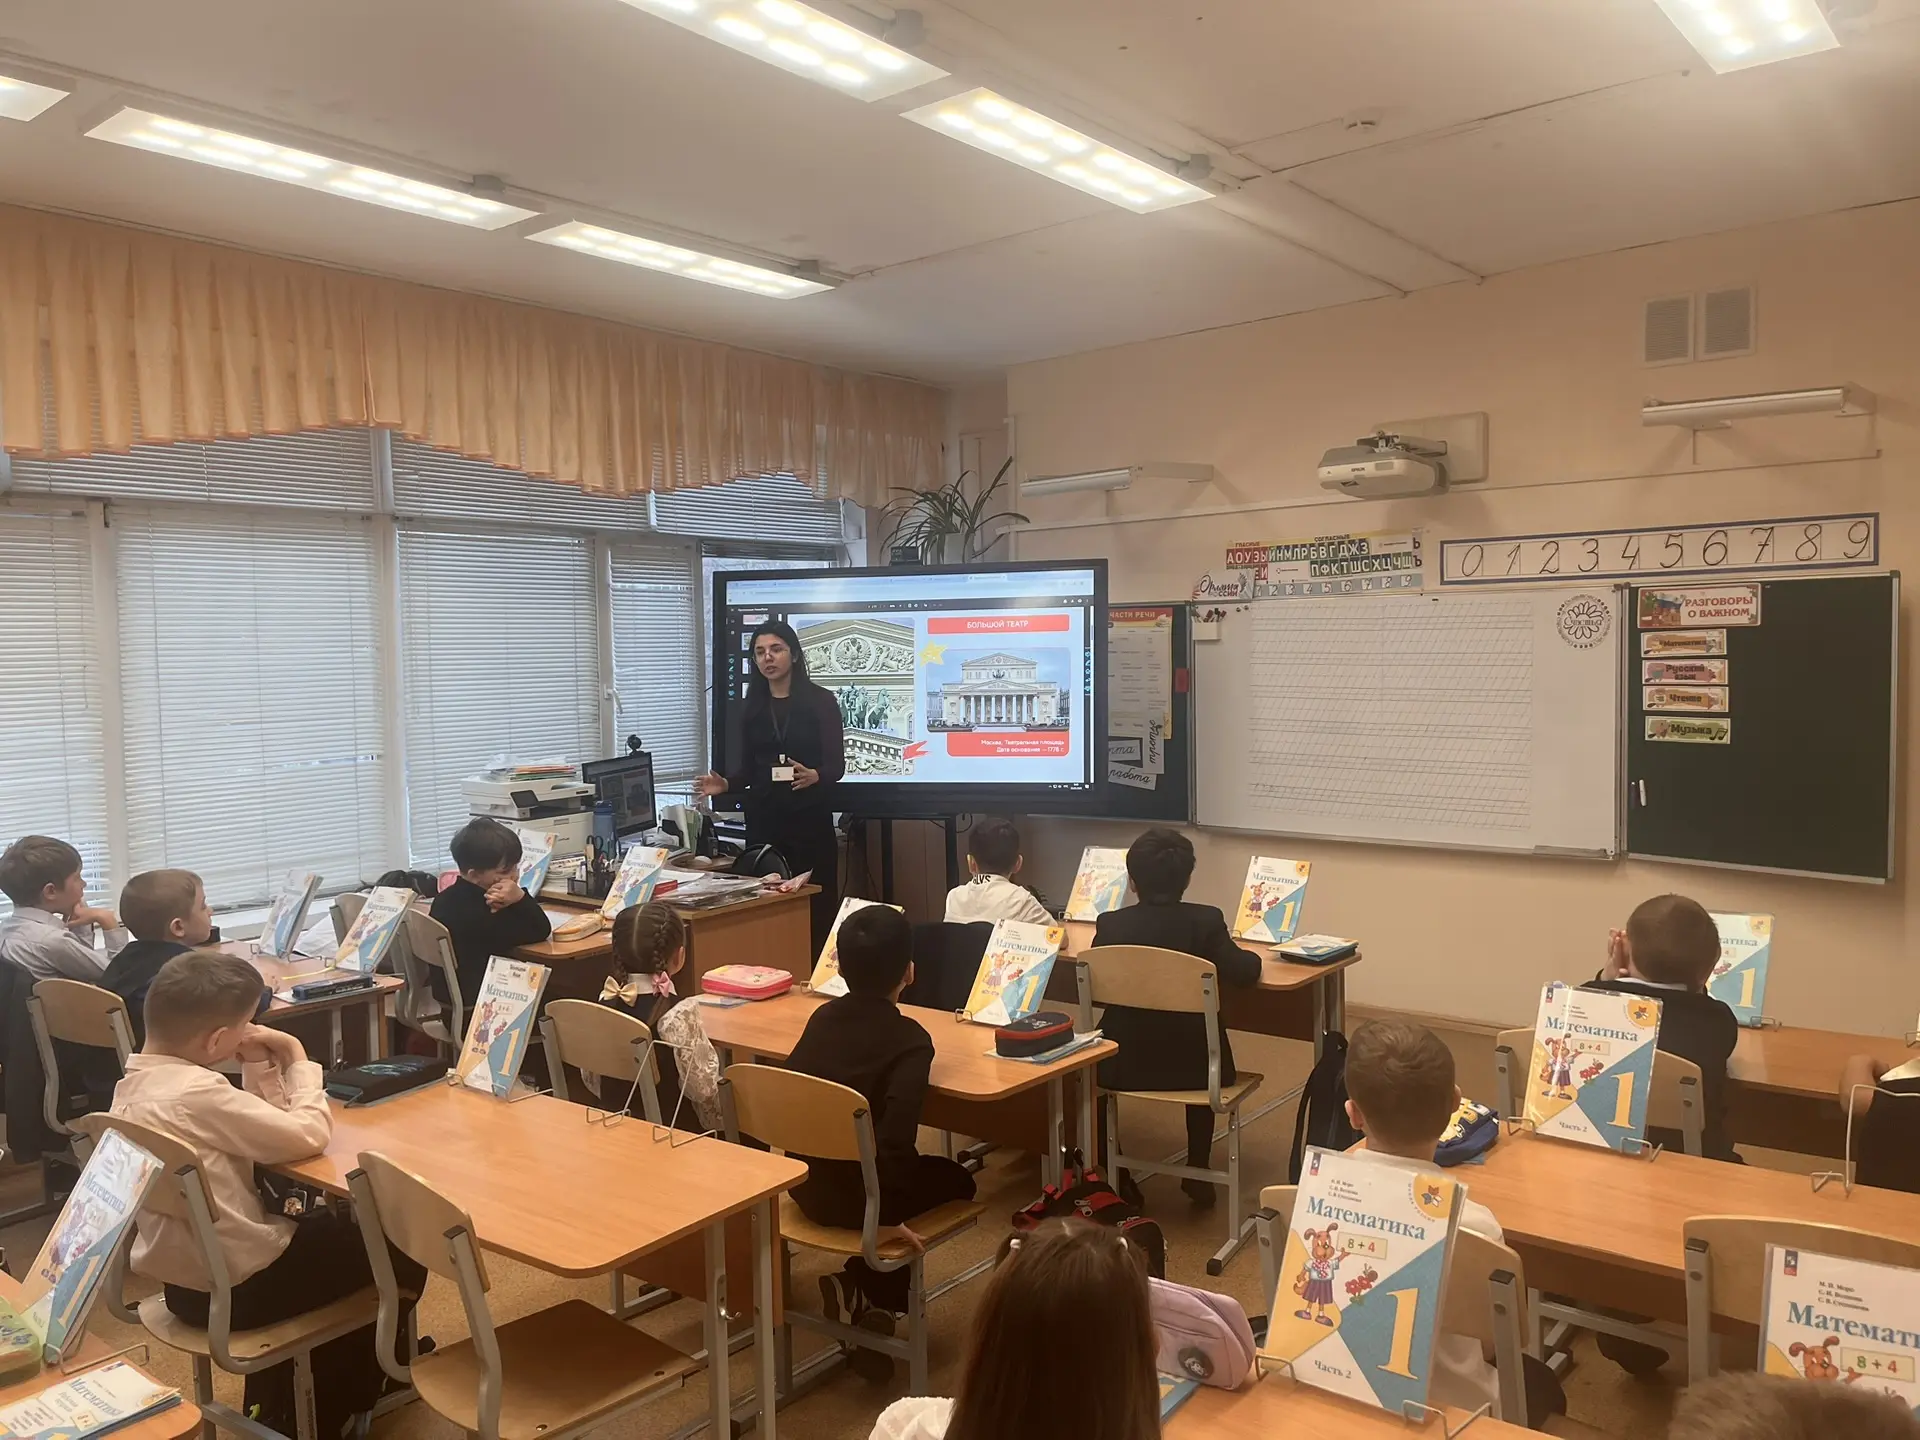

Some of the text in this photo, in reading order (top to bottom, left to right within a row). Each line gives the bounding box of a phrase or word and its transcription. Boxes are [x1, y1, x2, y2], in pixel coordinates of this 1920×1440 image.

[1314, 534, 1350, 542] СОГЛАСНЫЕ
[1461, 520, 1870, 577] 0 1 2 3 4 5 6 7 8 9
[1684, 596, 1753, 607] РАЗГОВОРЫ
[1688, 608, 1750, 618] О ВАЖНОМ
[967, 620, 1029, 629] БОЛЬШОЙ ТЕАТР
[1666, 664, 1704, 674] Русский
[1670, 694, 1702, 702] Чтение
[1670, 724, 1712, 735] Музыка
[1109, 768, 1151, 783] работа
[1252, 871, 1300, 886] Математика
[1277, 901, 1296, 932] 1
[996, 938, 1048, 954] Математика
[486, 984, 528, 1002] Математика
[1016, 975, 1040, 1012] 1
[1735, 967, 1756, 1008] 1
[1545, 1016, 1638, 1042] Математика
[498, 1027, 520, 1076] 1
[1606, 1072, 1636, 1130] 1
[1558, 1120, 1582, 1132] Часть
[1306, 1196, 1427, 1240] Математика
[1348, 1238, 1354, 1250] 8
[1367, 1241, 1376, 1253] 4
[57, 1255, 100, 1329] 1
[1376, 1287, 1420, 1380] 1
[1314, 1360, 1352, 1379] Часть 2
[1856, 1355, 1866, 1370] 8
[1887, 1360, 1898, 1374] 4
